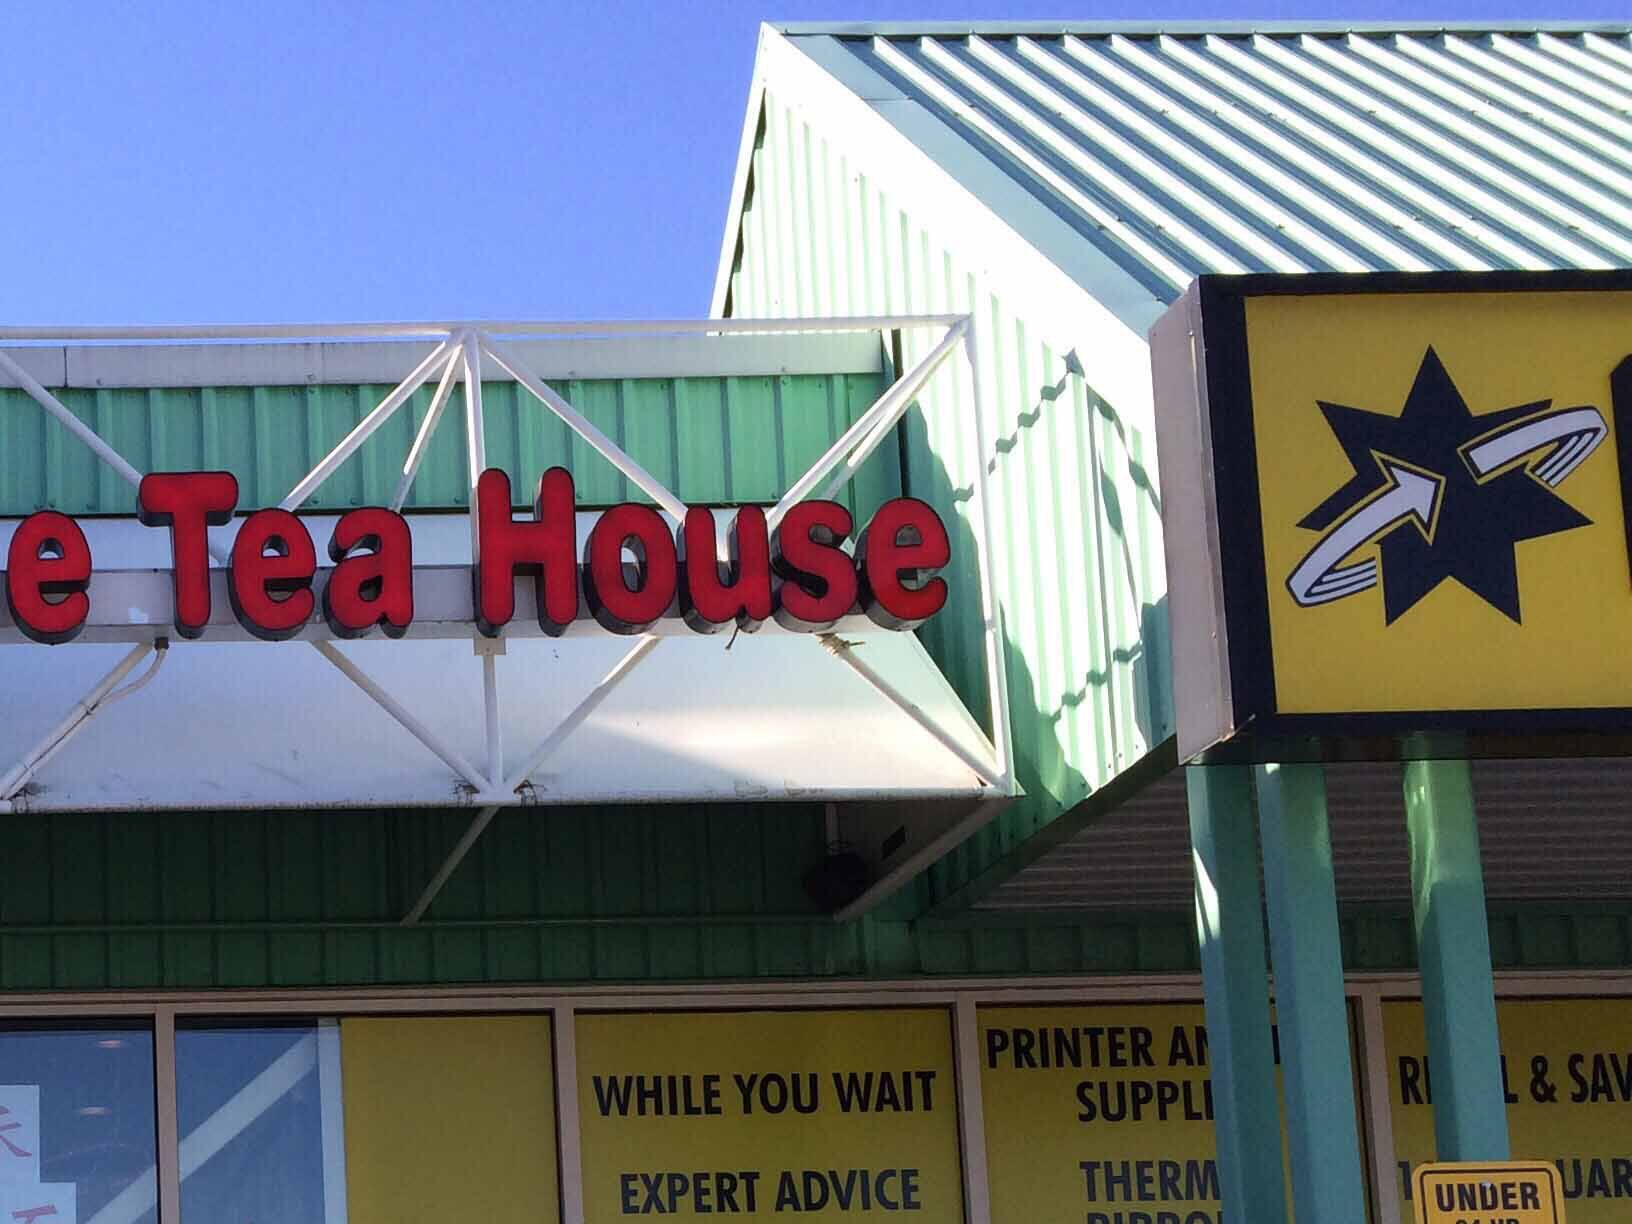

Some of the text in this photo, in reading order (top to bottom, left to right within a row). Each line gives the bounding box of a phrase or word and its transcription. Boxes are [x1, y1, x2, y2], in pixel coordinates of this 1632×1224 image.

[137, 470, 415, 641] Tea
[473, 466, 952, 638] House
[986, 1025, 1210, 1069] PRINTER AN
[593, 1071, 937, 1117] WHILE YOU WAIT
[1076, 1080, 1215, 1122] SUPPLI
[1529, 1054, 1557, 1104] &
[620, 1169, 922, 1215] EXPERT ADVICE
[1079, 1159, 1221, 1202] THERM
[1435, 1182, 1541, 1213] UNDER
[1555, 1157, 1632, 1200] UAR
